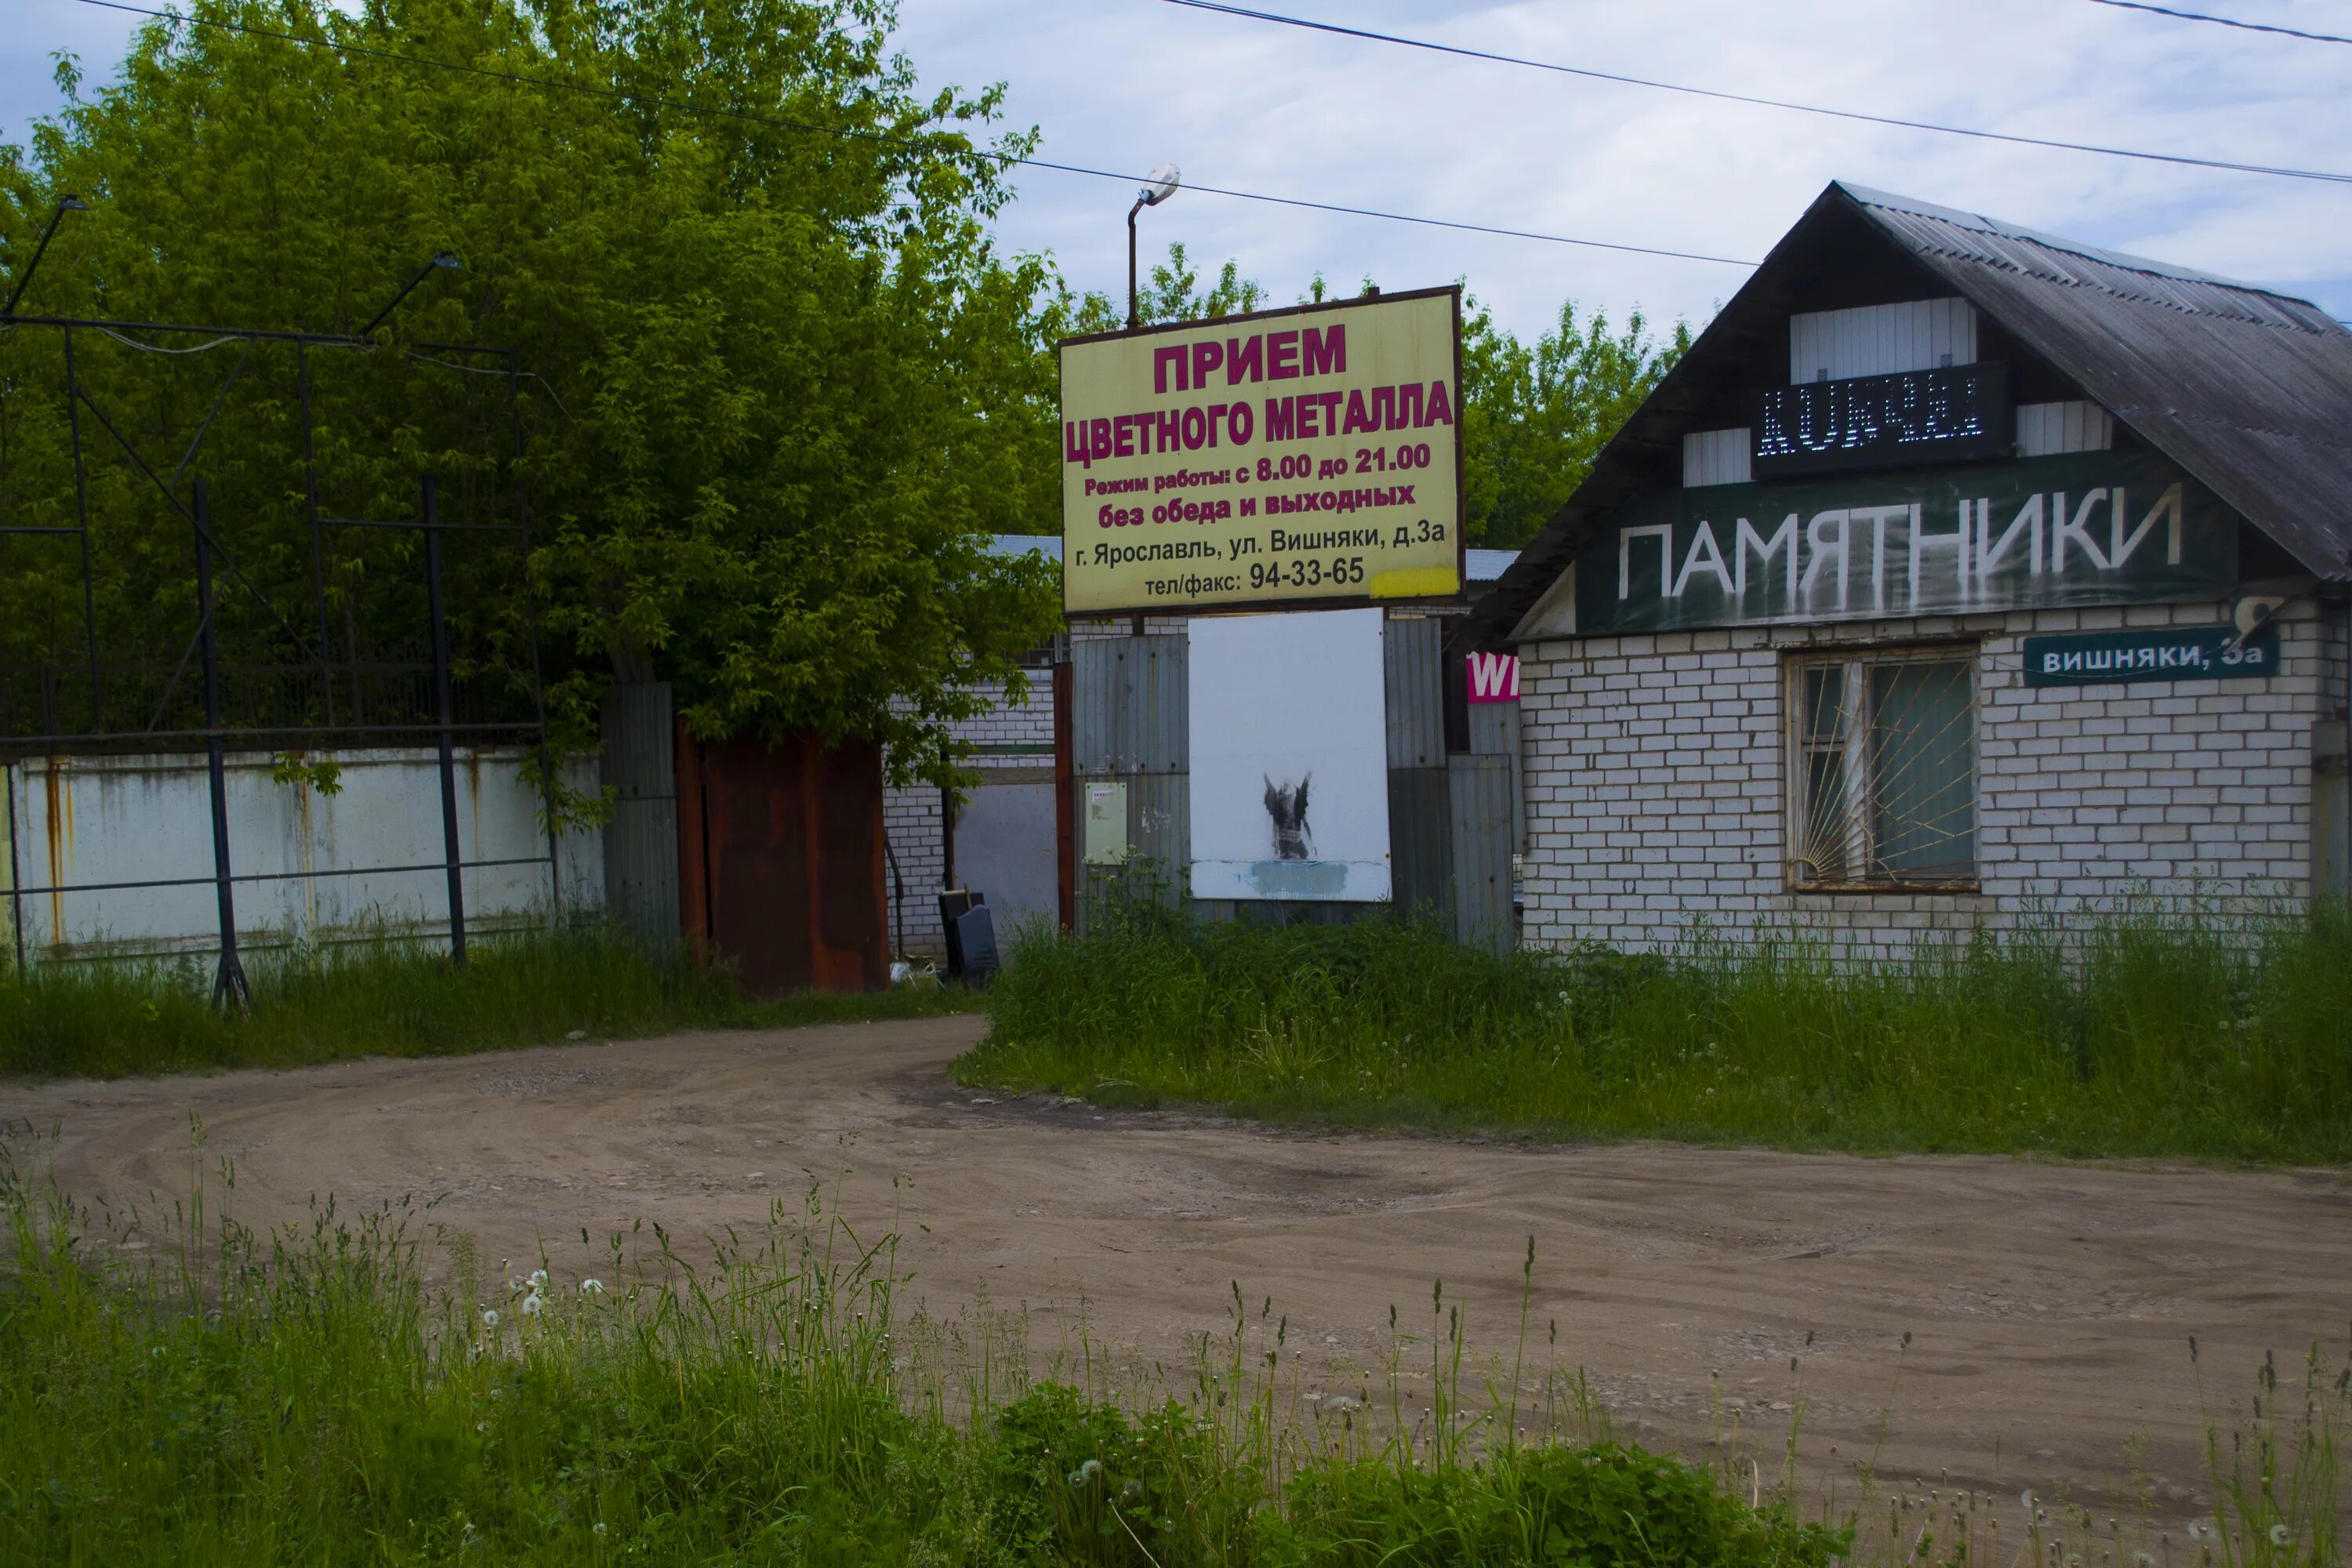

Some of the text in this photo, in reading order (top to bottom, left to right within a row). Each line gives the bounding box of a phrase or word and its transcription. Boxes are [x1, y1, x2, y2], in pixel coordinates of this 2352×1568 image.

[1154, 324, 1346, 394] ПРИЕМ
[1066, 380, 1454, 469] ЦВЕТНОГО МЕТАЛЛА
[1085, 443, 1431, 496] Режим работы: с 8.00 до 21.00
[1098, 485, 1416, 528] без обеда и выходных
[1076, 550, 1087, 566] г.
[1093, 540, 1222, 569] Ярославль,
[1229, 537, 1262, 561] ул.
[1271, 528, 1385, 553] Вишняки,
[1618, 481, 2183, 602] ПАМЯТНИКИ
[1145, 557, 1364, 599] тел/факс: 94-33-65
